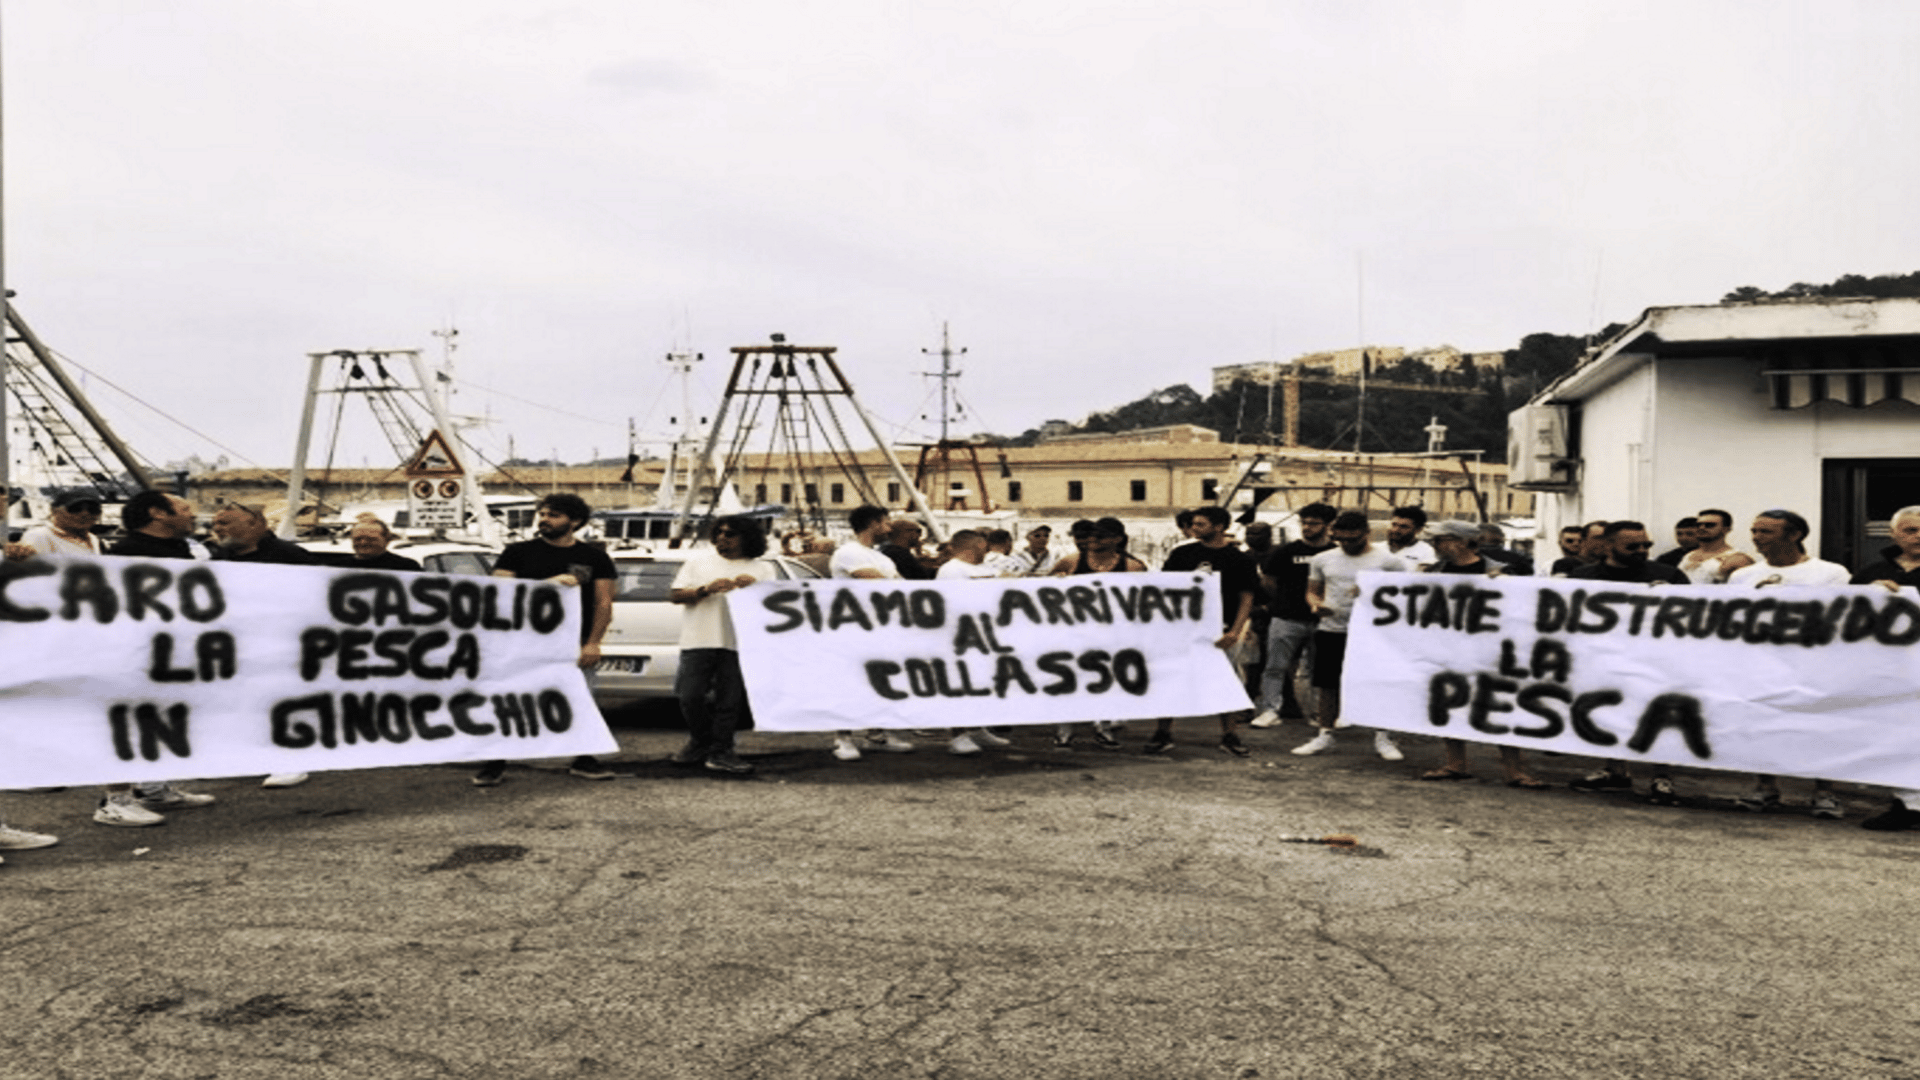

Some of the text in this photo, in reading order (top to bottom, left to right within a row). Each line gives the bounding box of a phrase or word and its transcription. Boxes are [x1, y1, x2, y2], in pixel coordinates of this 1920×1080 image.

[0, 559, 565, 634] CARO GASOLIO
[1372, 584, 1502, 636] STATE
[150, 628, 480, 683] LA PESCA
[953, 612, 1014, 655] AL
[864, 648, 1150, 701] COLLASSO
[1500, 638, 1573, 684] LA
[109, 689, 573, 762] IN GINOCCHIO
[1428, 671, 1712, 761] PESCA
